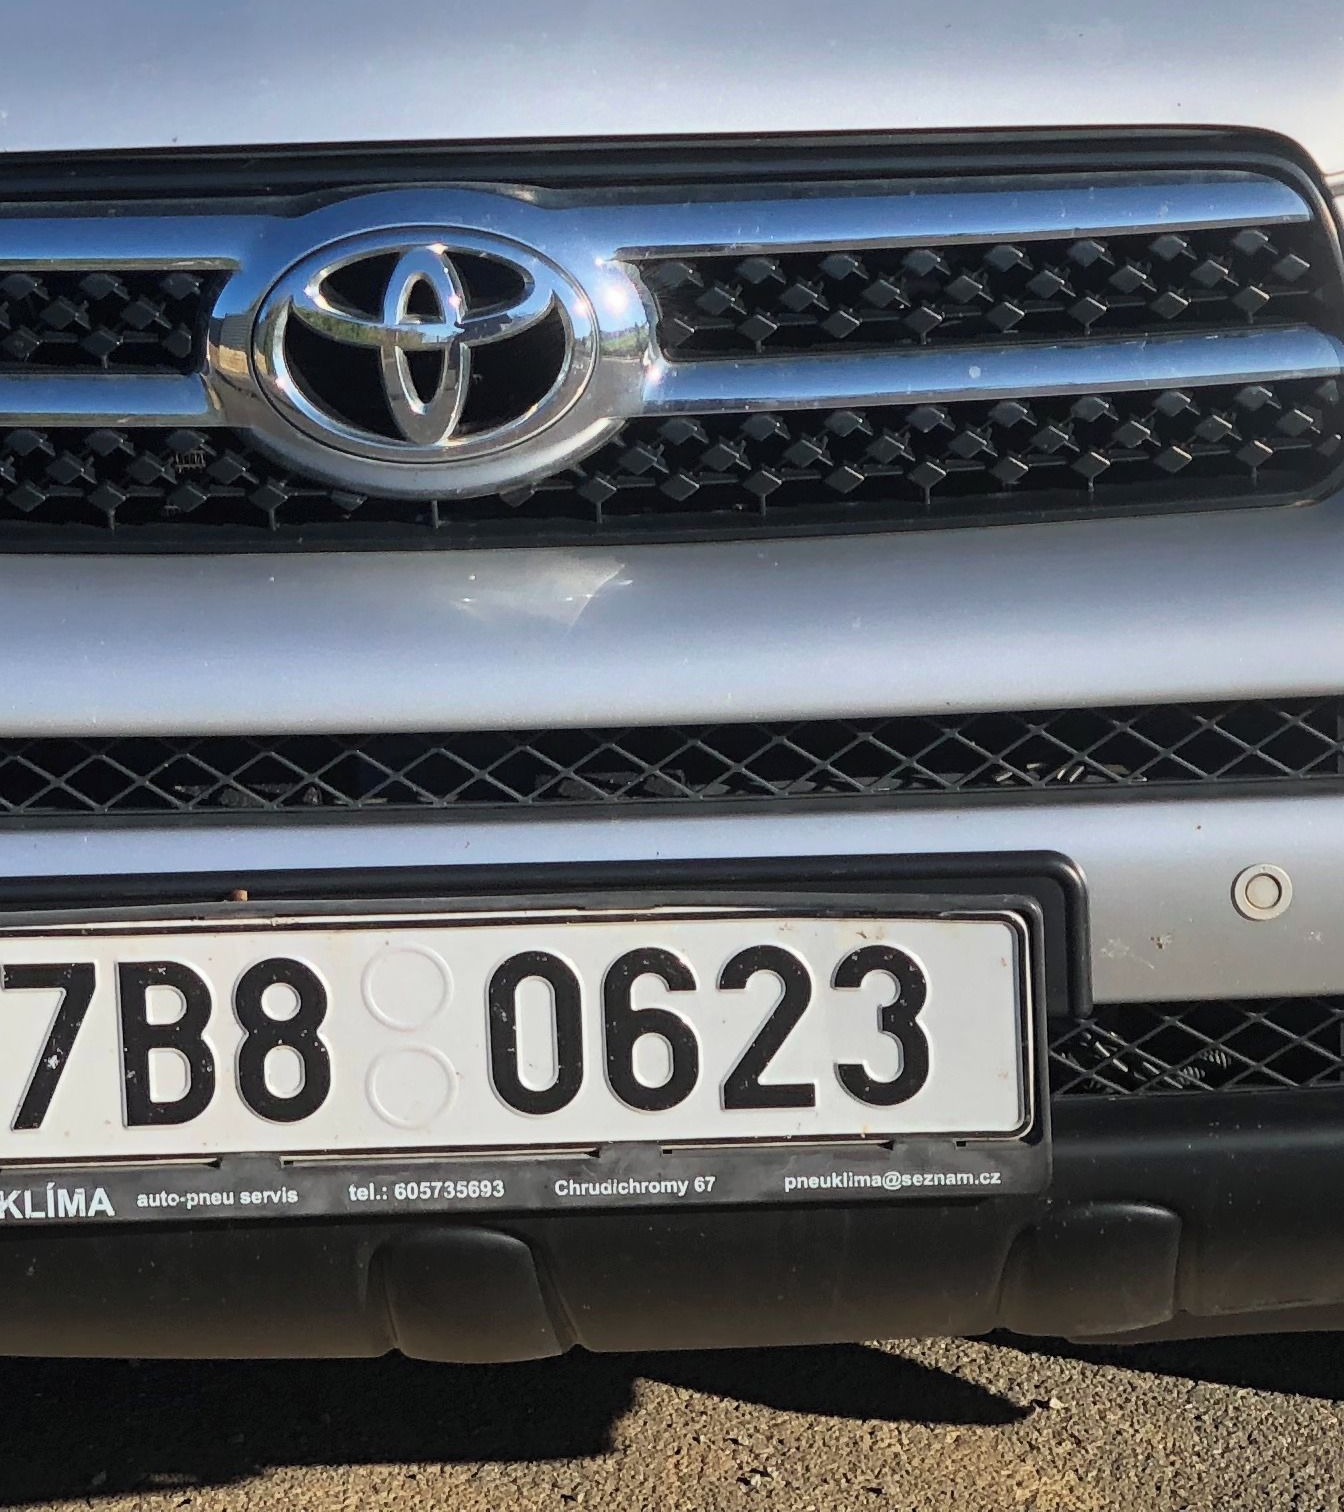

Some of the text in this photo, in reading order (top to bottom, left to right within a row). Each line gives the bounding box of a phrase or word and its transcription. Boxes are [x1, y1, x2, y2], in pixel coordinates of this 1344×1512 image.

[1, 943, 931, 1132] 7B8 0623
[348, 1179, 506, 1202] tel.: 605735693
[554, 1175, 716, 1198] Chrudichromy 67
[784, 1169, 1002, 1193] pneuklima@seznam.cz
[136, 1185, 299, 1210] auto-pneu servis
